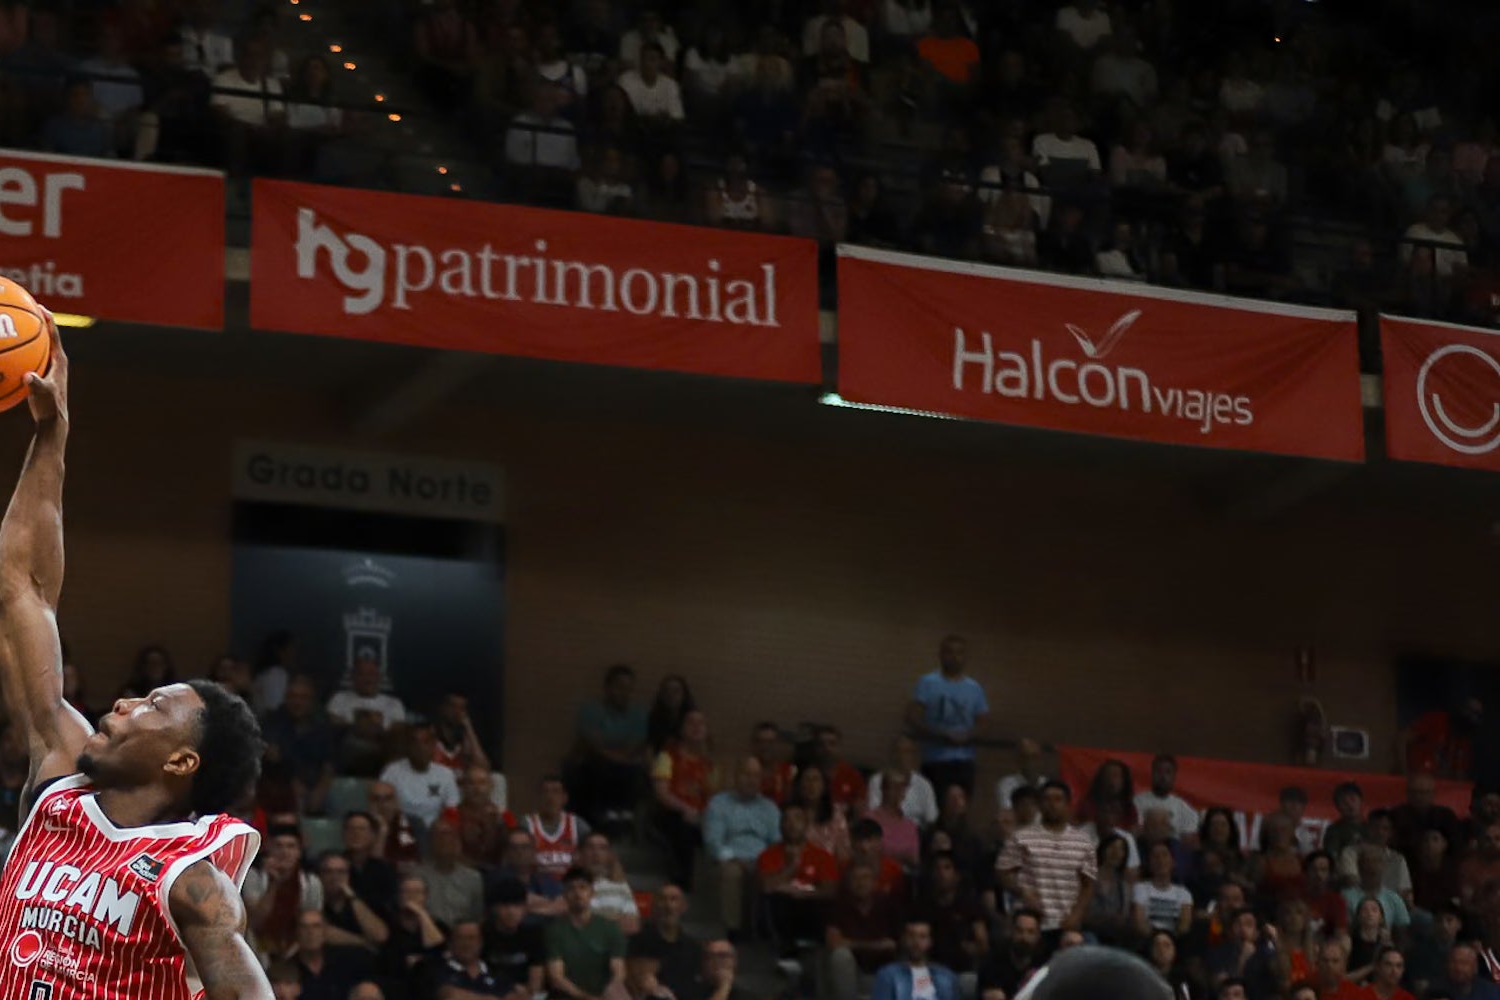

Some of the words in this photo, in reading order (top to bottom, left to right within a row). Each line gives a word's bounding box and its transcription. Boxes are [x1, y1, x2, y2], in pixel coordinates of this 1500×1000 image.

[390, 238, 781, 328] patrimonial
[245, 453, 369, 492] Grada
[387, 466, 492, 505] Norte
[15, 860, 141, 937] UCAM
[21, 906, 101, 950] MURCIA
